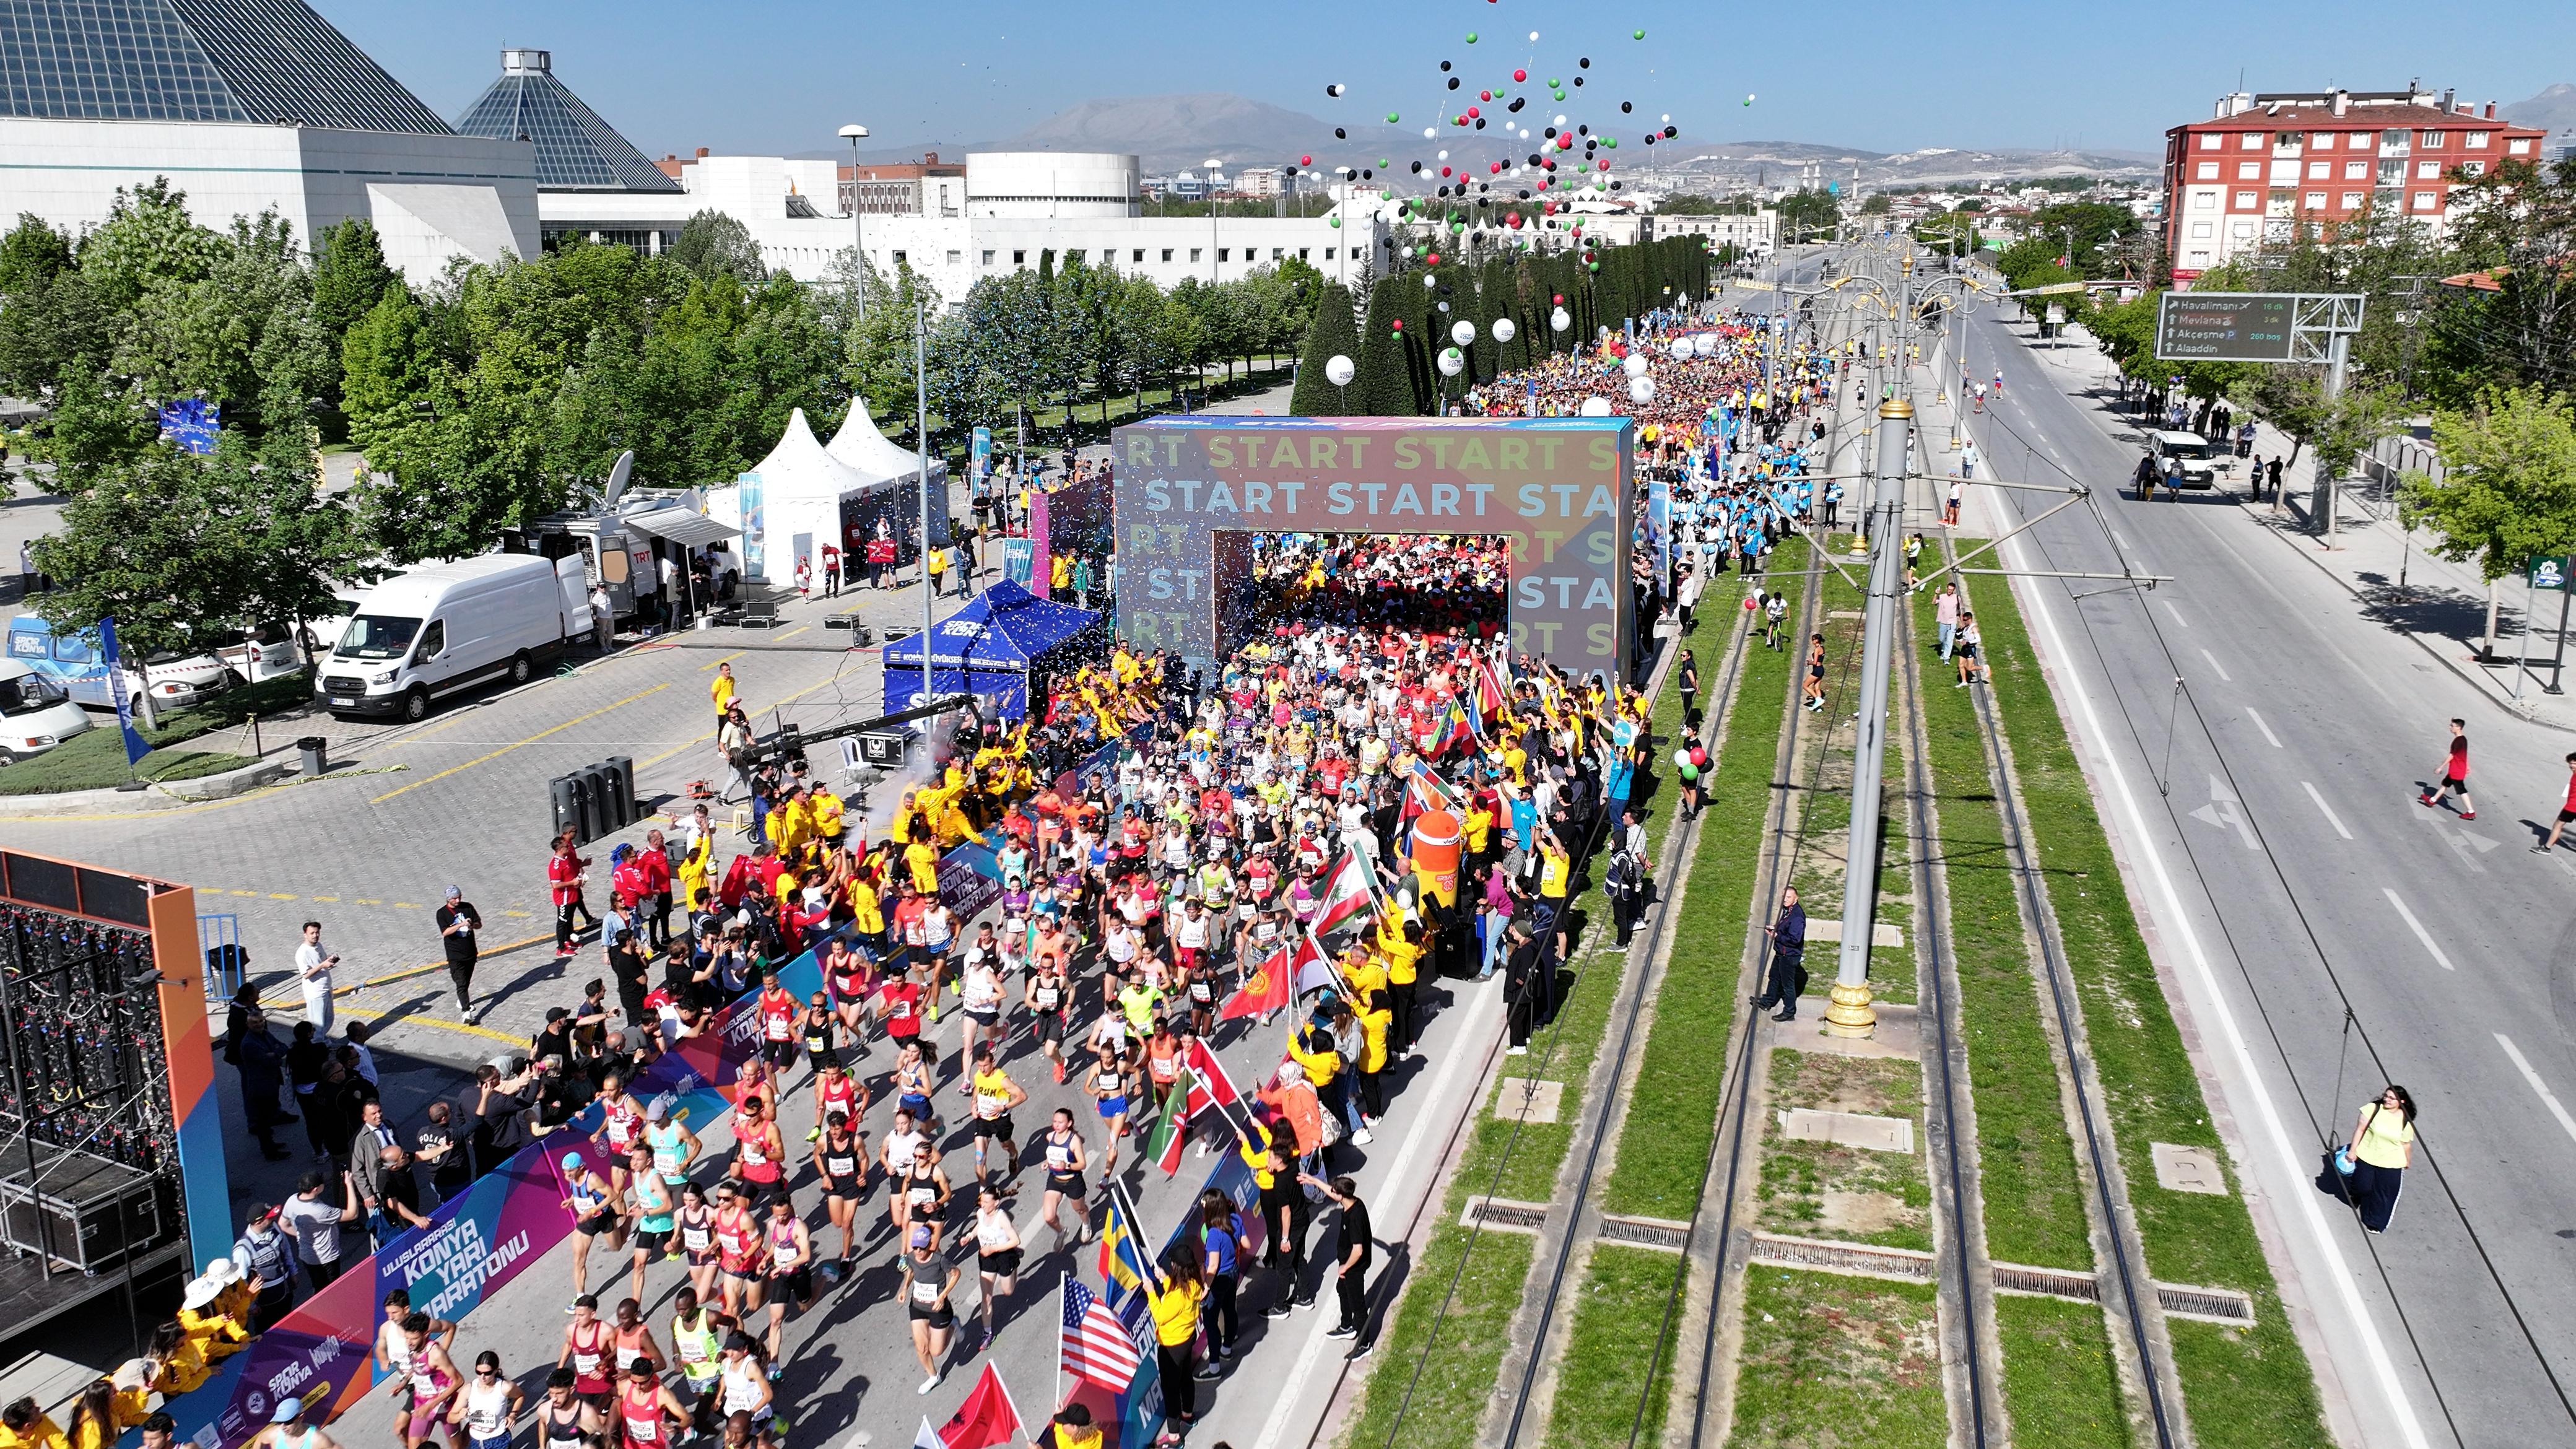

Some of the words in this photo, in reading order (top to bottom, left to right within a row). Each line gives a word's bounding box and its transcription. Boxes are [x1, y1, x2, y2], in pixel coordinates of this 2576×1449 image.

[2179, 315, 2221, 324] Mevlana
[2181, 300, 2237, 310] Havalimanı
[2175, 344, 2217, 353] Alaaddin
[2177, 329, 2225, 340] Akçeşme
[2266, 333, 2281, 341] boş
[1115, 435, 1186, 466] RT
[1208, 435, 1372, 469] START
[1395, 437, 1565, 471] START
[1145, 480, 1305, 513] START
[1328, 482, 1494, 516] START
[1518, 484, 1616, 516] STA
[1116, 524, 1188, 555] RT
[633, 550, 650, 564] TRT
[1148, 567, 1212, 600] ST
[1518, 576, 1615, 609] STA
[15, 636, 40, 646] SPOR
[941, 627, 991, 640] KONYA
[943, 620, 988, 631] SPOR
[15, 642, 46, 654] KONYA
[110, 656, 133, 730] KONYA
[938, 863, 974, 895] KONYA
[952, 877, 999, 917] ARATONU
[381, 1217, 456, 1277] ULUSLARARASI
[403, 1218, 479, 1287] KONYA
[435, 1236, 487, 1286] YARI
[268, 1360, 300, 1393] SPOR
[273, 1365, 313, 1403] KONYA
